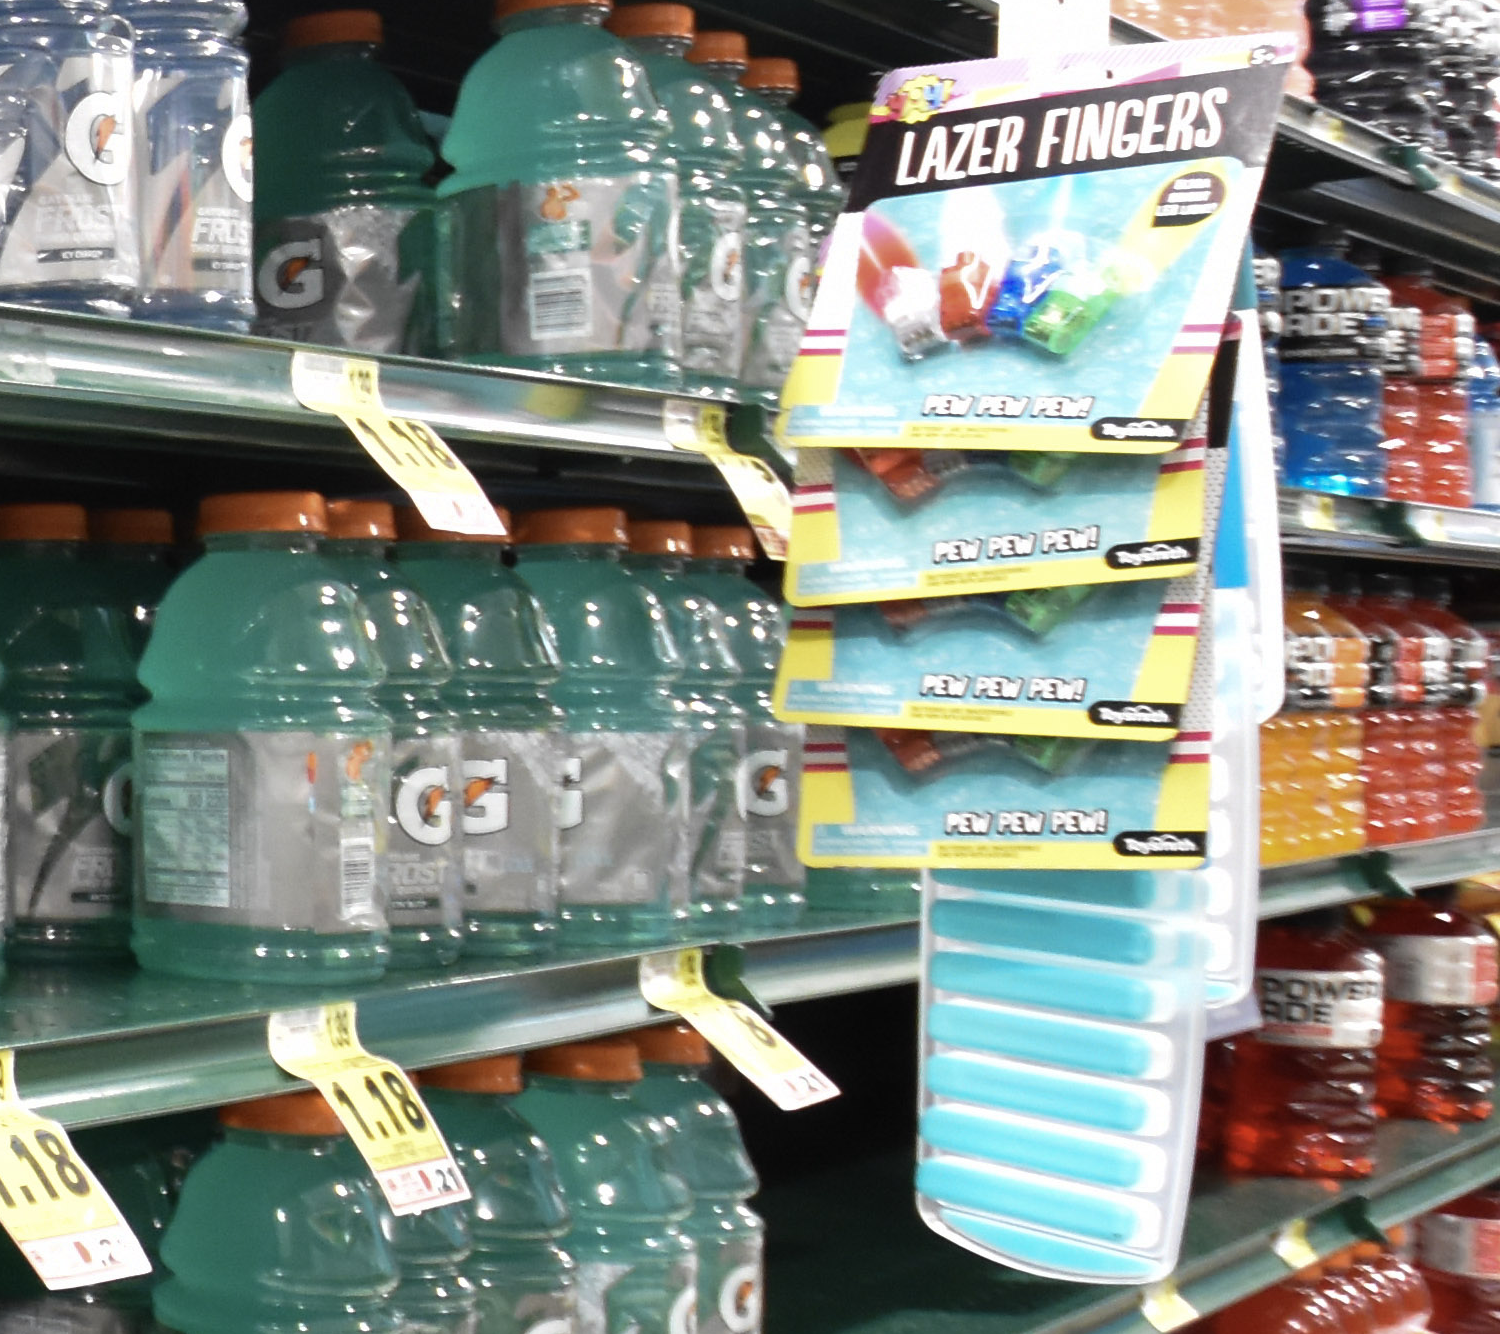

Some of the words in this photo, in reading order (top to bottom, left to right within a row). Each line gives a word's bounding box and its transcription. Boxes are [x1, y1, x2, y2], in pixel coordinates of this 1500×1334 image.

[895, 116, 1025, 186] LAZER
[1035, 86, 1229, 169] FINGERS
[923, 395, 974, 417] PEW
[977, 396, 1028, 417] PEW
[1031, 395, 1095, 418] PEW!
[934, 539, 982, 564] PEW
[987, 533, 1036, 559] PEW
[1042, 525, 1101, 554] PEW!
[920, 675, 969, 698] PEW
[973, 675, 1024, 699] PEW
[1027, 677, 1088, 701] PEW!
[944, 811, 993, 835] PEW
[997, 811, 1045, 835] PEW
[1051, 810, 1108, 835] PEW!
[332, 1071, 428, 1140] 1.18
